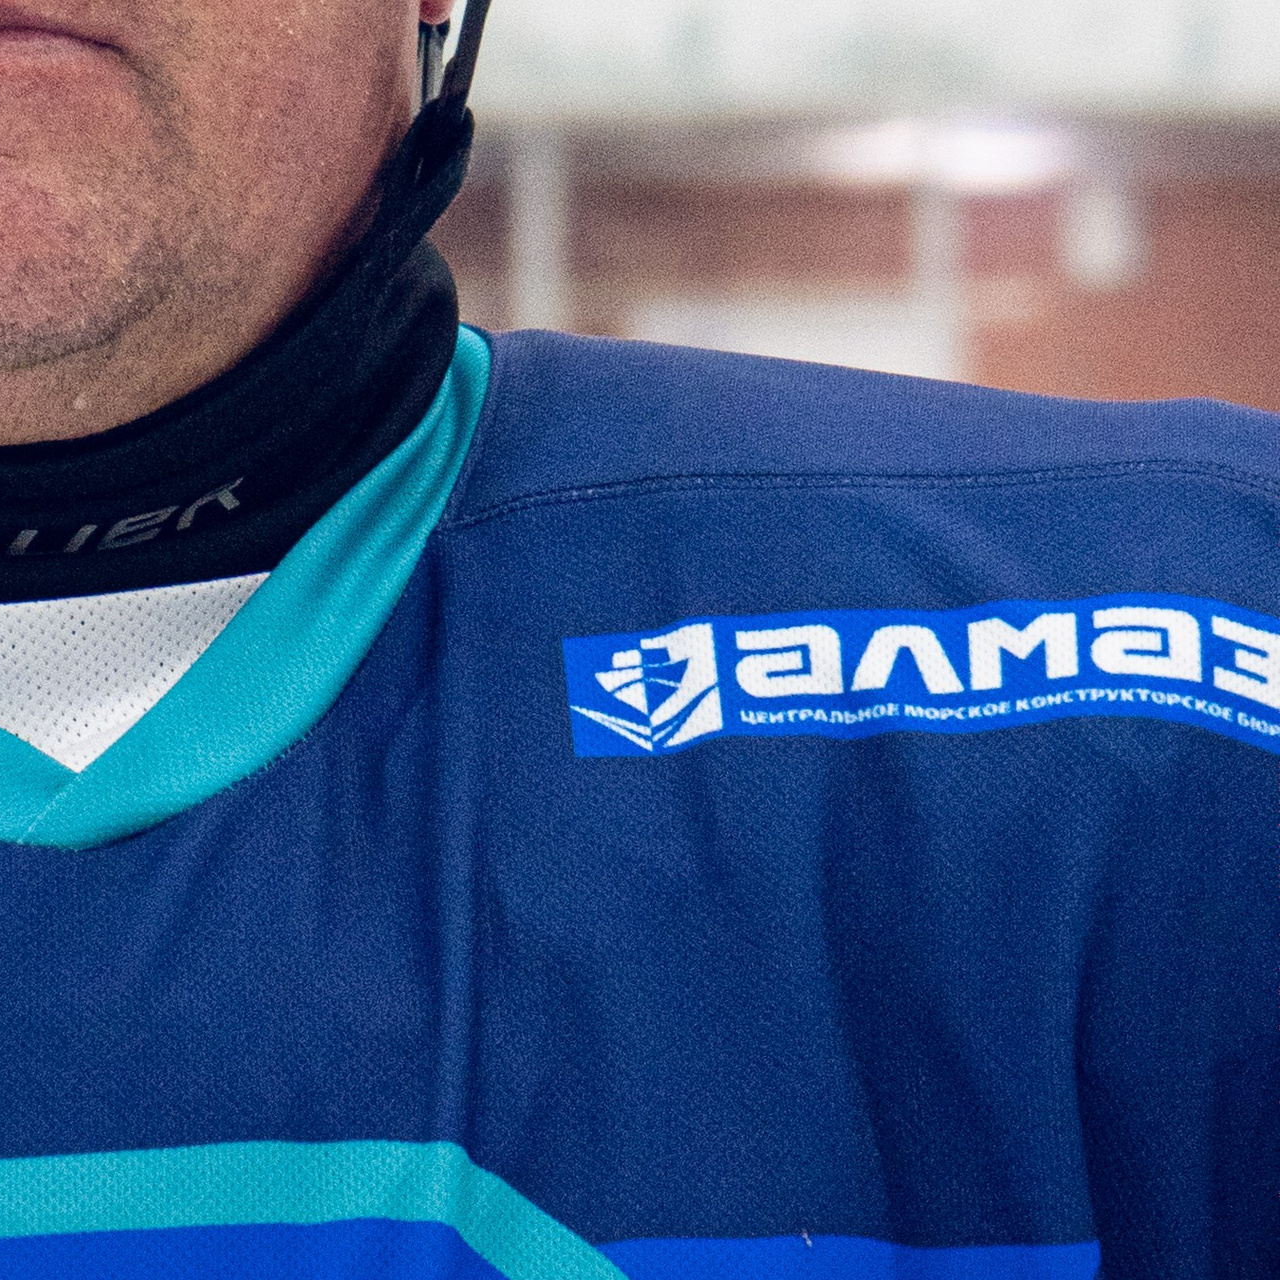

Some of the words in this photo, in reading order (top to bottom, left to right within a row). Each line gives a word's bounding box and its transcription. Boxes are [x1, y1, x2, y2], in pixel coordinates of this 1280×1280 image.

[739, 702, 900, 725] ЦЕНТРАЛЬНОЕ
[903, 701, 1010, 721] МОРСКОЕ
[1015, 687, 1233, 722] КОНСТРУКТОРСКОЕ
